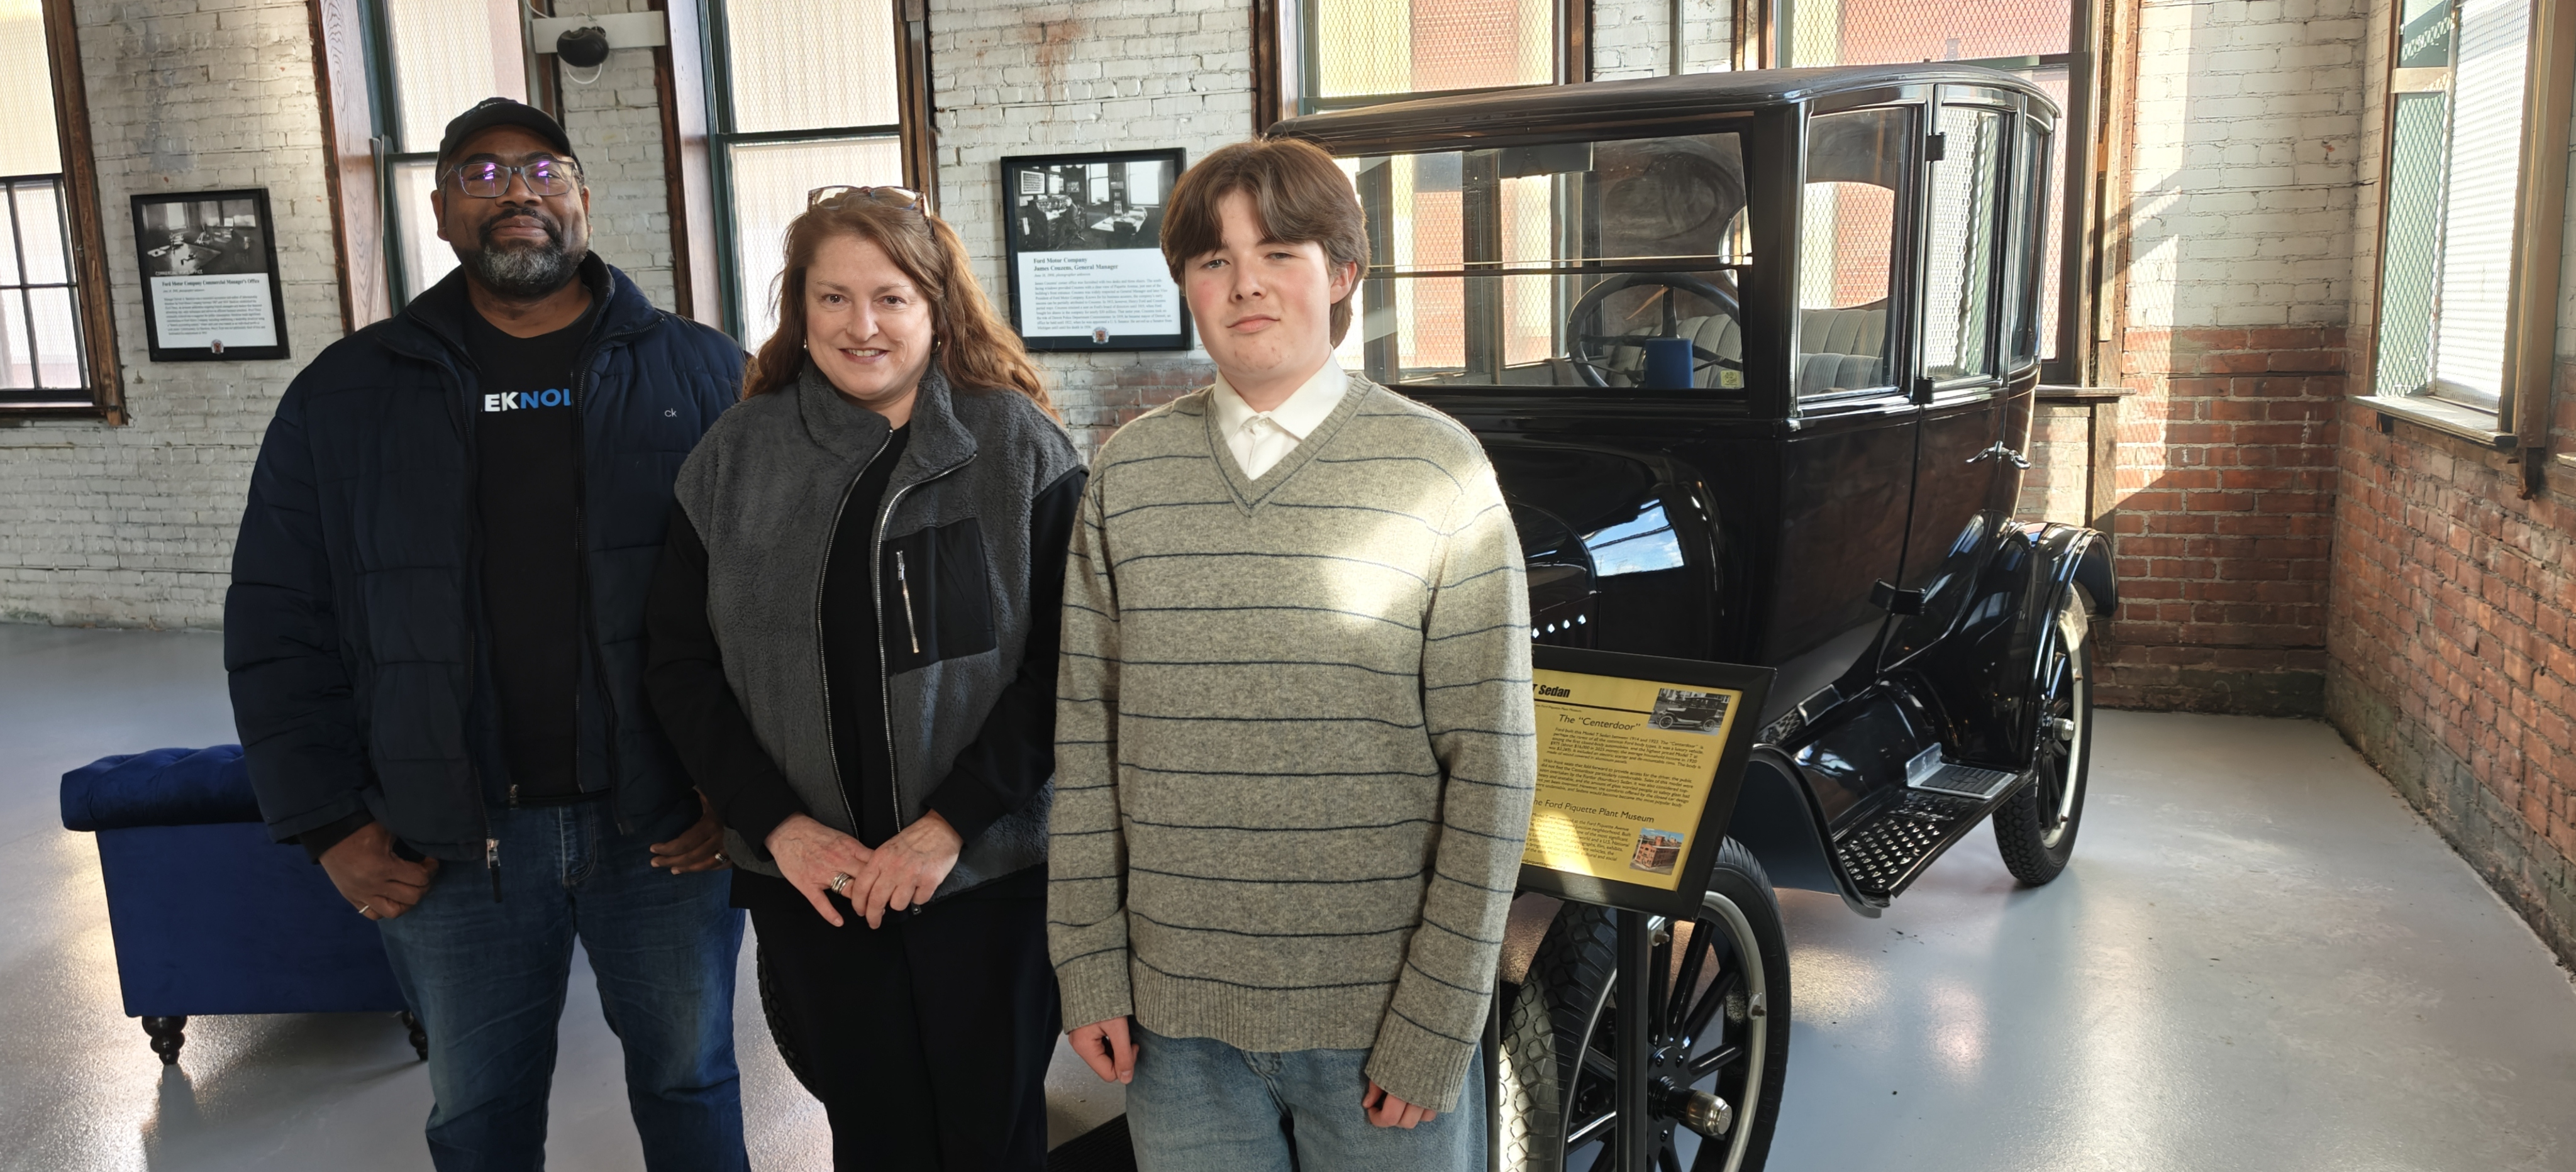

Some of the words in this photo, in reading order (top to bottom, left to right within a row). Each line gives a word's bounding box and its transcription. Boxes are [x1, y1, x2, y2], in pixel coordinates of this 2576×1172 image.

[481, 389, 571, 412] EKNOL
[664, 408, 677, 417] ck
[1538, 685, 1570, 698] Sedan
[1559, 714, 1575, 724] The
[1579, 717, 1641, 731] “Centerdoor”
[1533, 797, 1543, 806] he
[1545, 799, 1563, 809] Ford
[1565, 802, 1597, 815] Piquette
[1599, 807, 1619, 818] Plant
[1619, 810, 1654, 823] Museum
